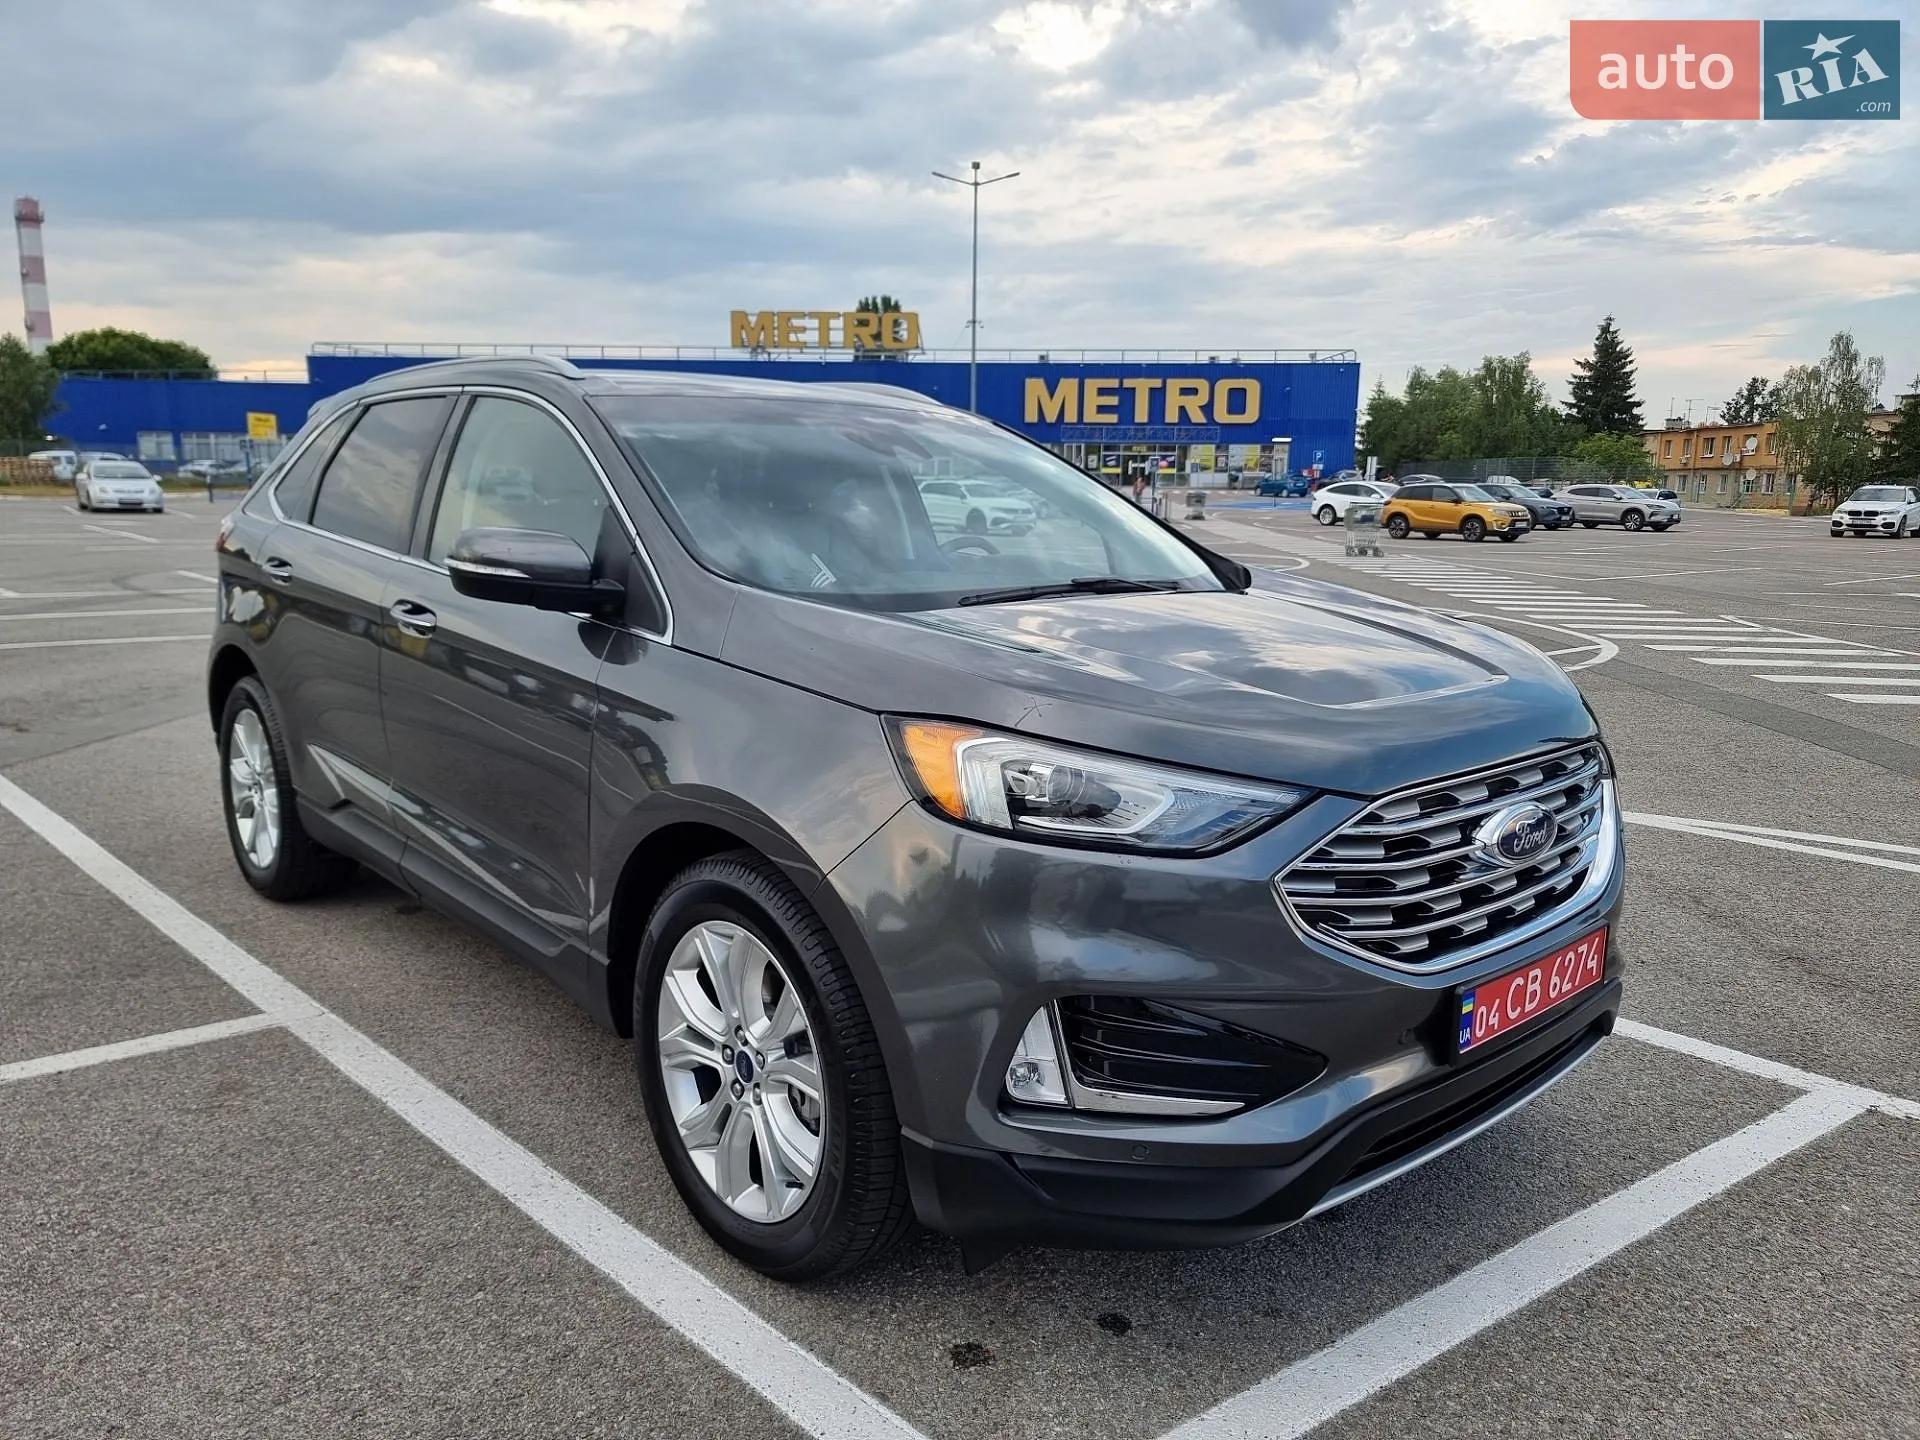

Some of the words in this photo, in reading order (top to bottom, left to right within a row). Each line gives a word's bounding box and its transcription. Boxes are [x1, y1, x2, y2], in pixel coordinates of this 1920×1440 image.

[730, 310, 919, 350] METRO
[1024, 377, 1261, 425] METRO
[1513, 815, 1548, 853] Ford
[1475, 998, 1500, 1038] 04
[1506, 968, 1542, 1020] CB
[1549, 937, 1600, 999] 6274
[1459, 1027, 1471, 1044] UA
